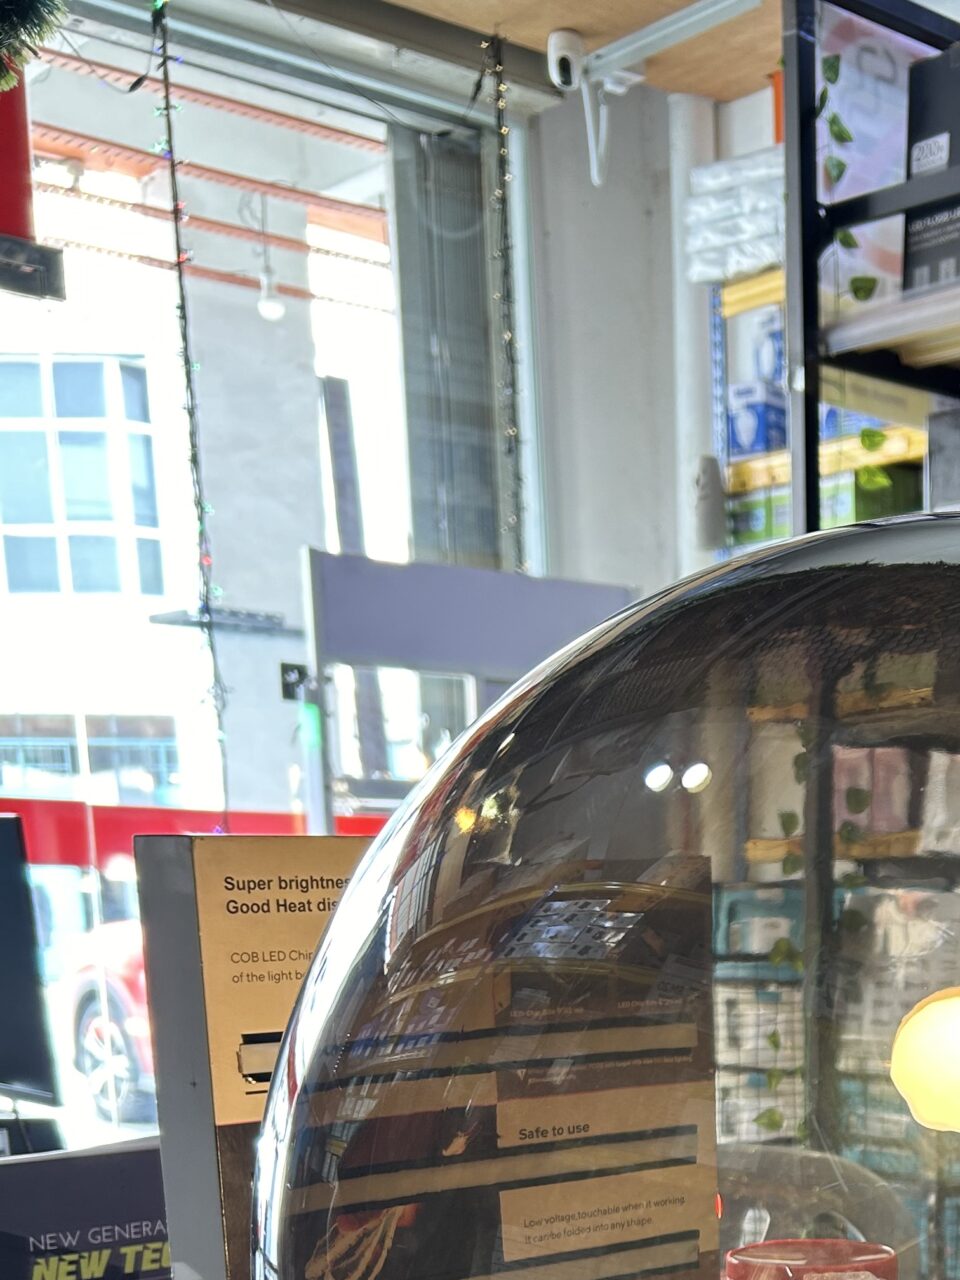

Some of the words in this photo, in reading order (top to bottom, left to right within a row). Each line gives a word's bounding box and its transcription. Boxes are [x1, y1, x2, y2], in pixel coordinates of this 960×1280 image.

[224, 876, 273, 894] Super
[226, 899, 271, 914] Good
[276, 899, 313, 913] Heat
[231, 951, 259, 964] COB
[262, 950, 287, 963] LED
[232, 972, 244, 984] of
[246, 971, 266, 983] the
[268, 970, 293, 984] light
[519, 1126, 548, 1141] Safe
[552, 1126, 564, 1137] to
[568, 1122, 590, 1135] use
[524, 1218, 543, 1228] Low
[622, 1201, 645, 1213] when
[29, 1230, 80, 1252] NEW
[88, 1219, 167, 1244] GENERA
[563, 1224, 591, 1237] folded
[592, 1222, 609, 1232] into
[611, 1221, 626, 1231] any
